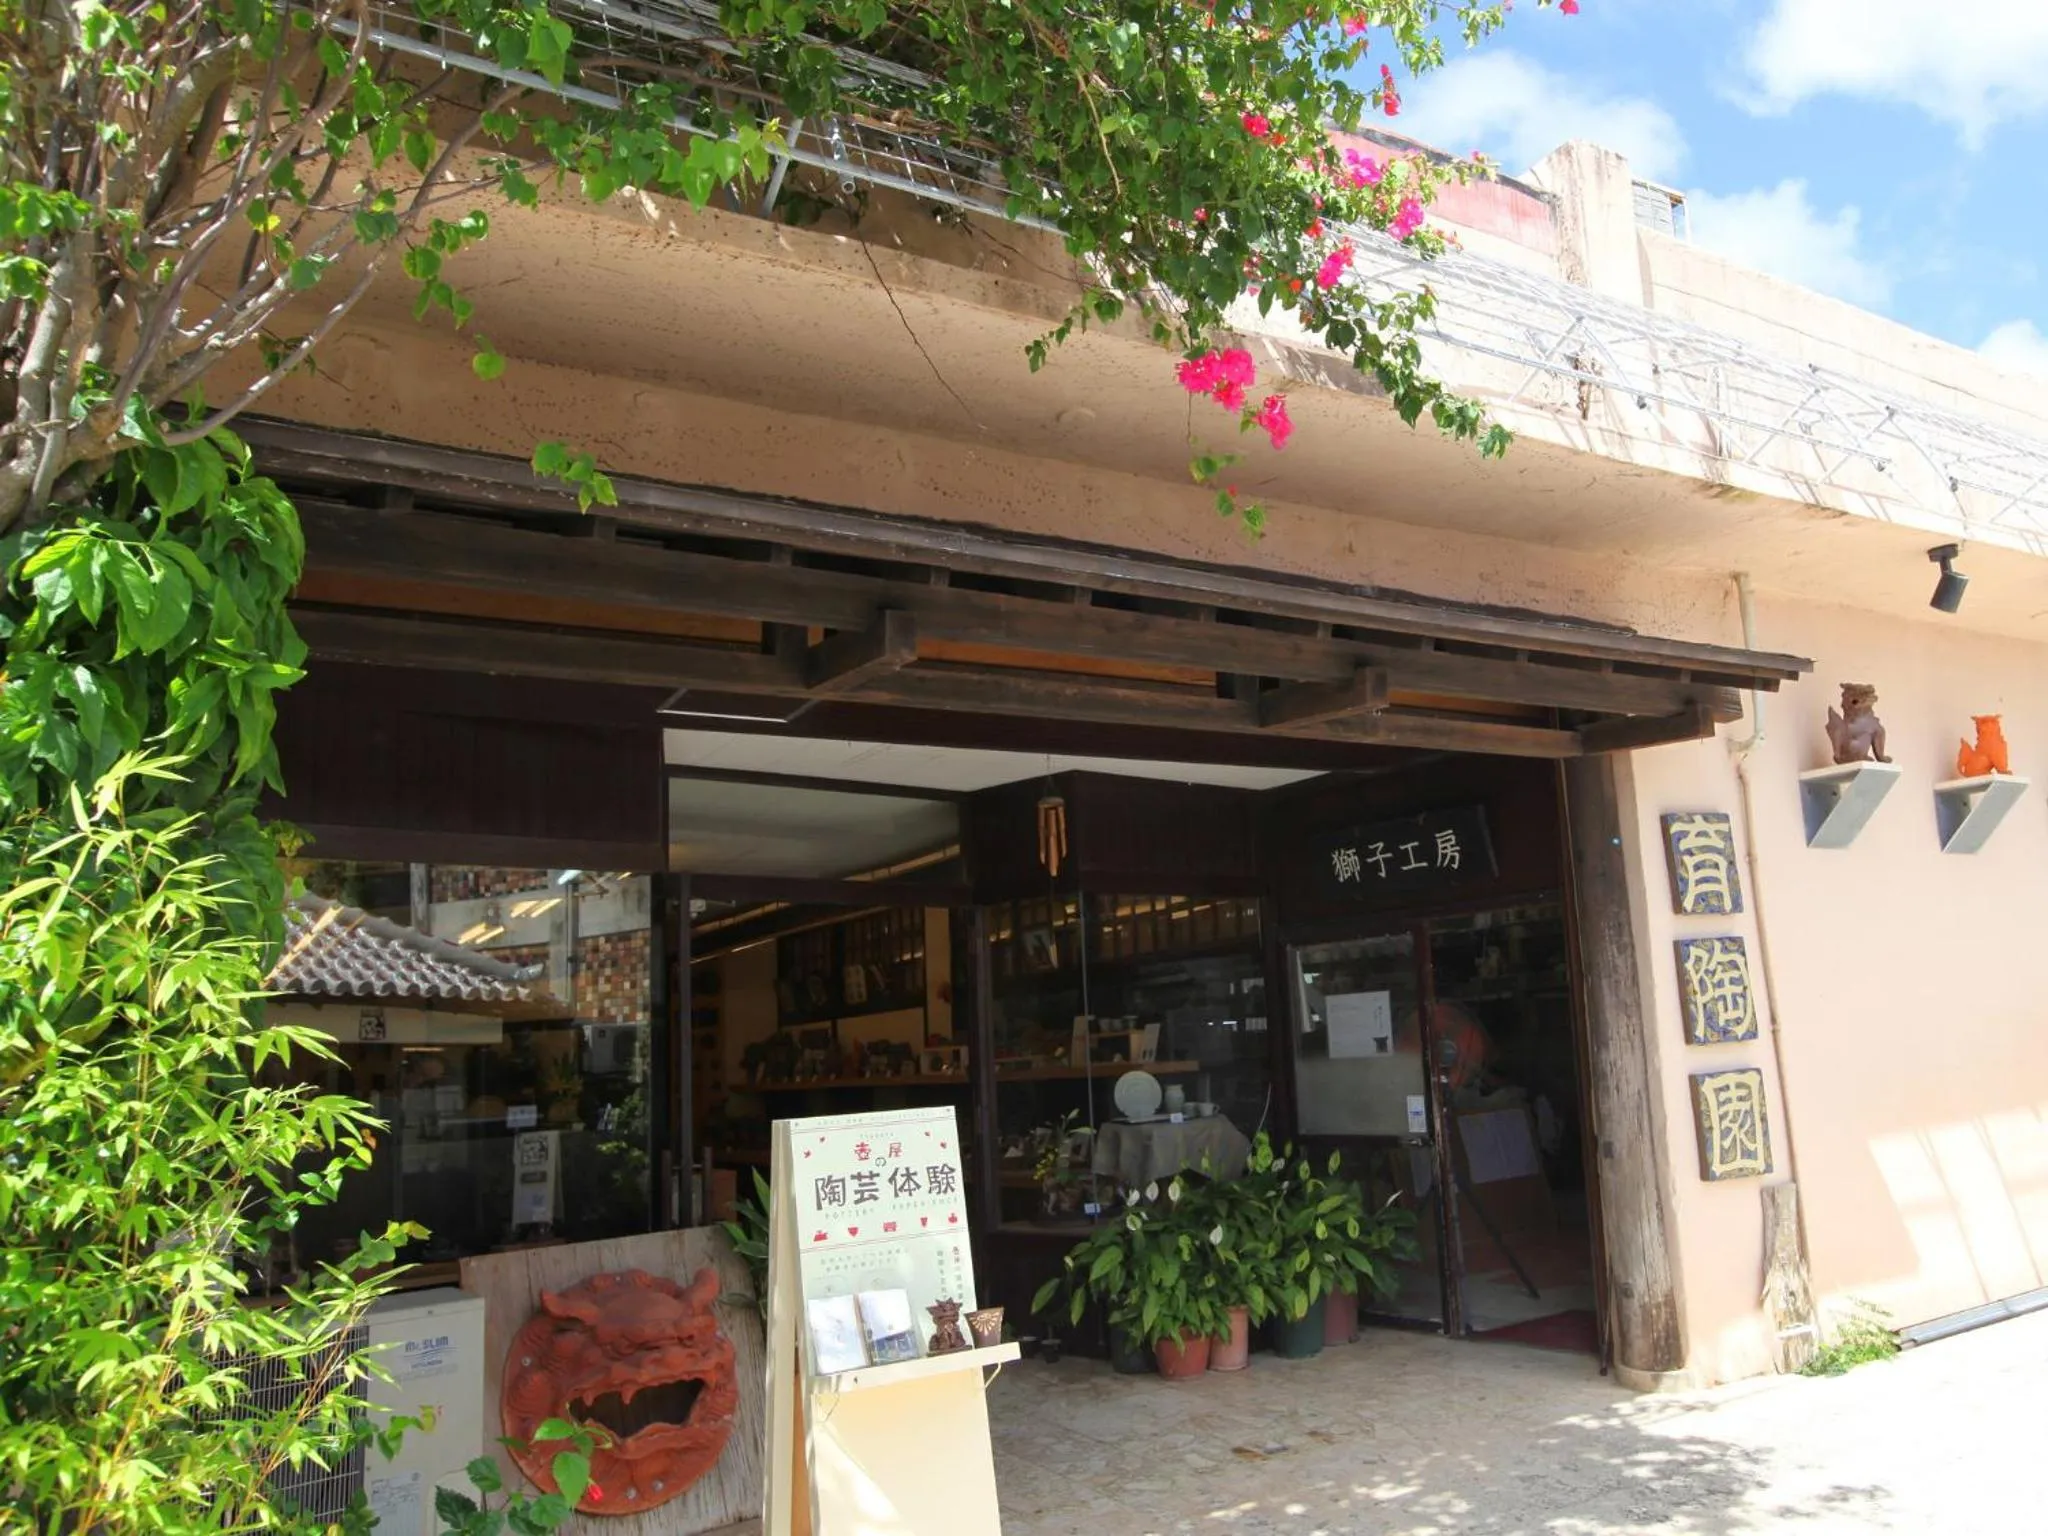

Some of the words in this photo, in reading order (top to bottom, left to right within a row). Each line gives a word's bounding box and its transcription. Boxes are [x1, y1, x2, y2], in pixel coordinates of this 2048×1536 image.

[1331, 829, 1462, 884] 獅子工房
[1670, 814, 1764, 1175] 育陶園
[814, 1163, 957, 1211] 陶芸体験
